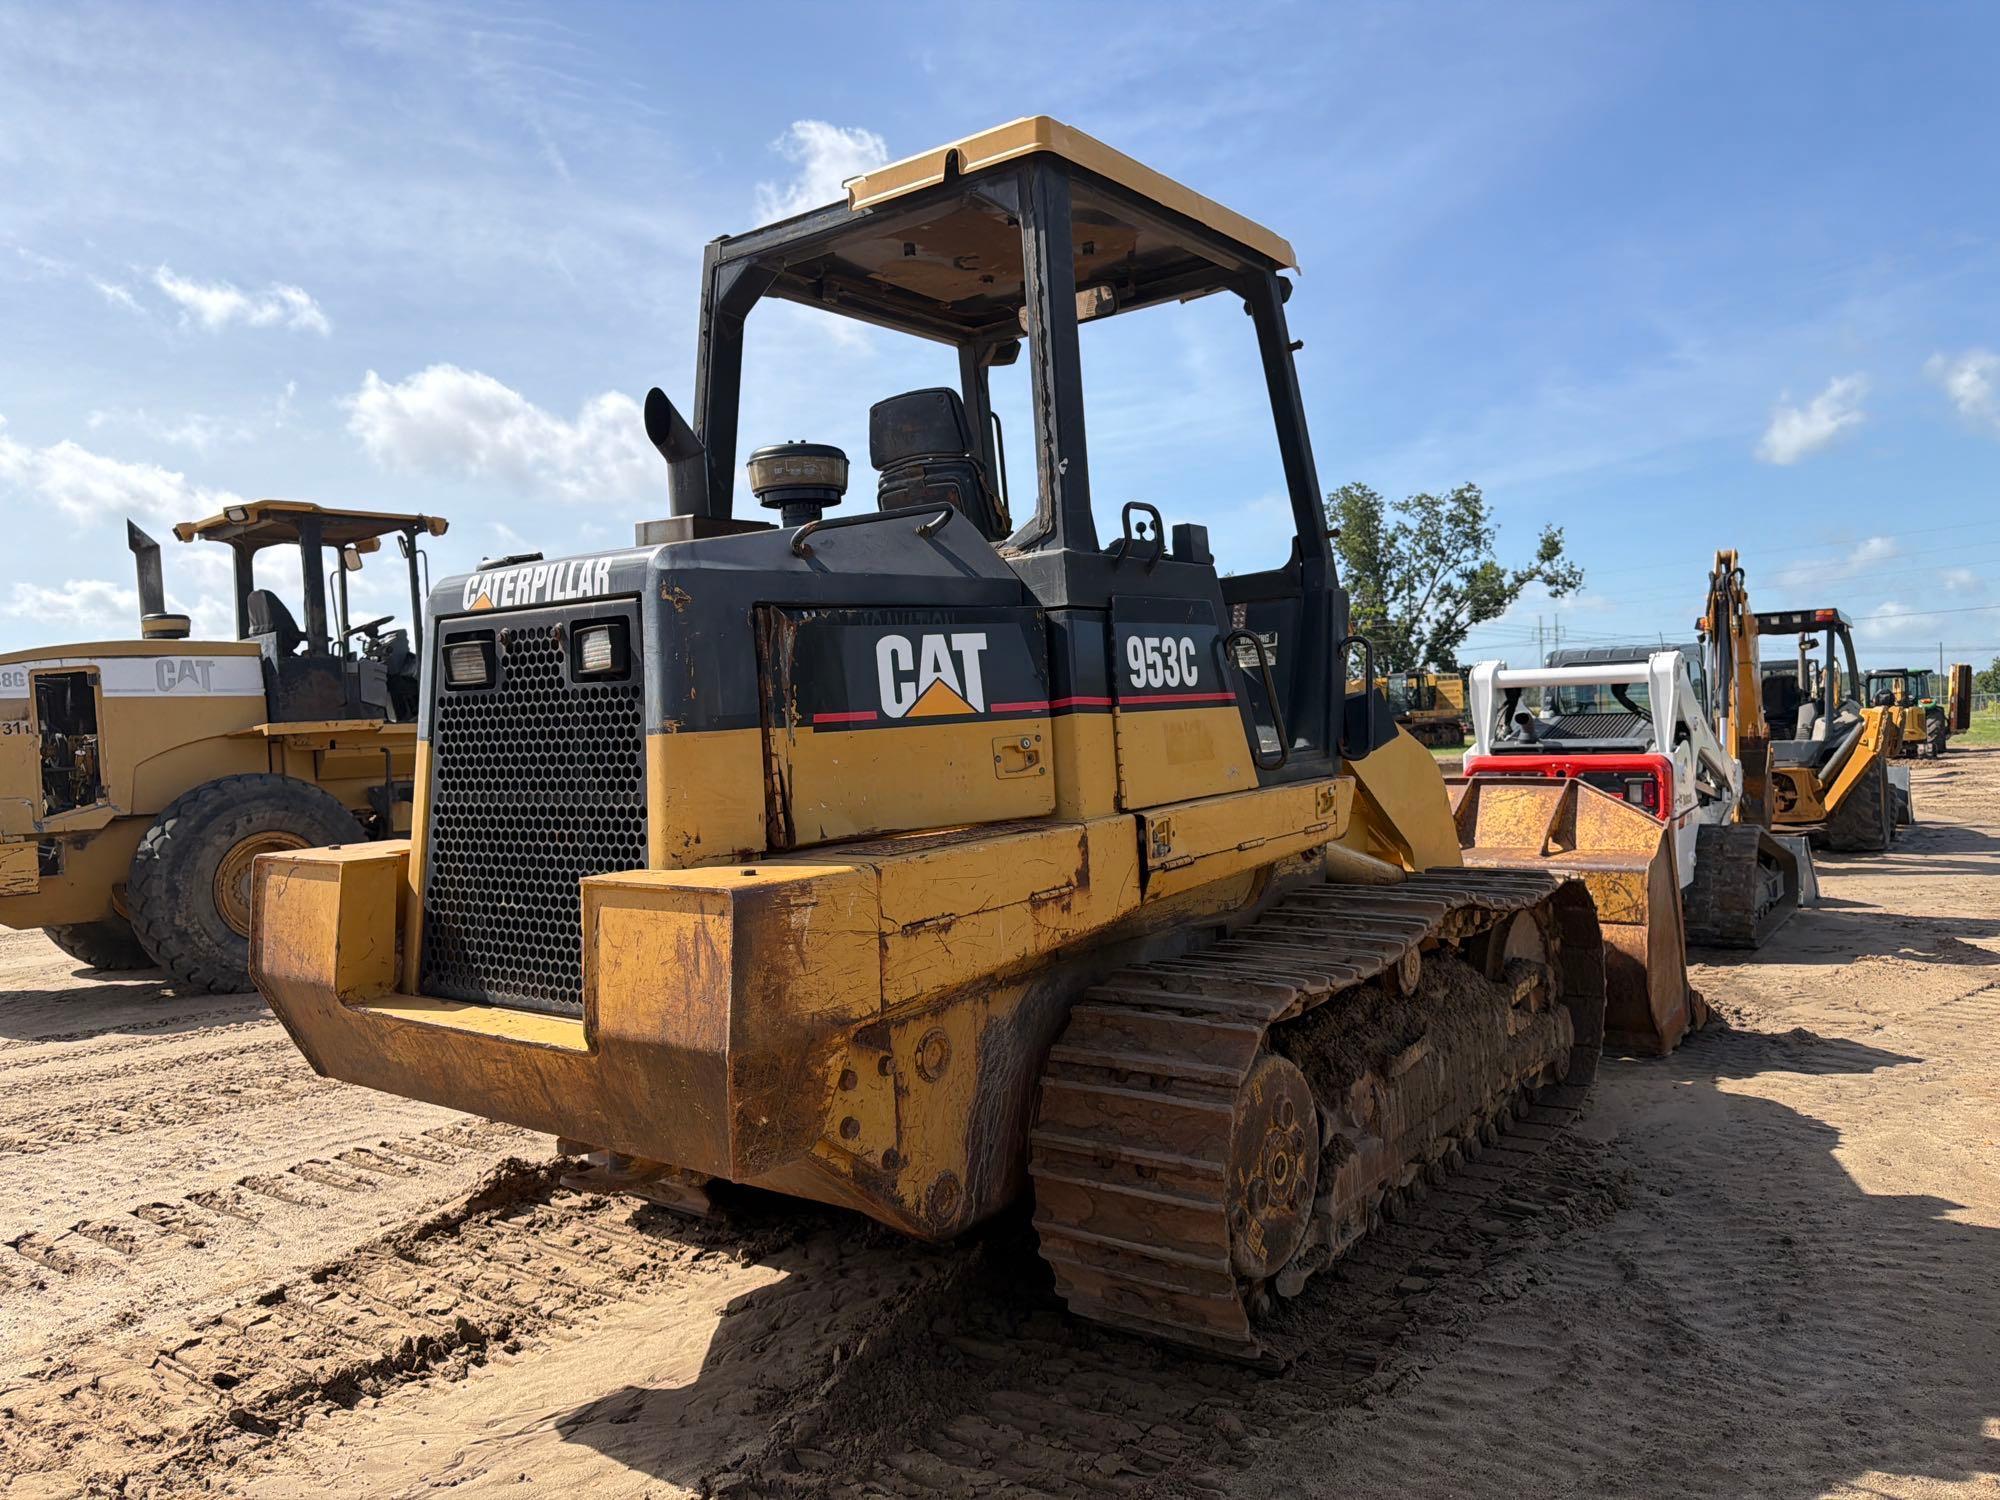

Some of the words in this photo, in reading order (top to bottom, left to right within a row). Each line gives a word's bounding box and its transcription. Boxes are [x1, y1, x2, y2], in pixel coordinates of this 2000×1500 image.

[463, 557, 613, 611] CATERPILLAR
[0, 671, 26, 688] 8G
[155, 659, 215, 692] CAT
[876, 633, 987, 718] CAT
[1126, 635, 1198, 688] 953C
